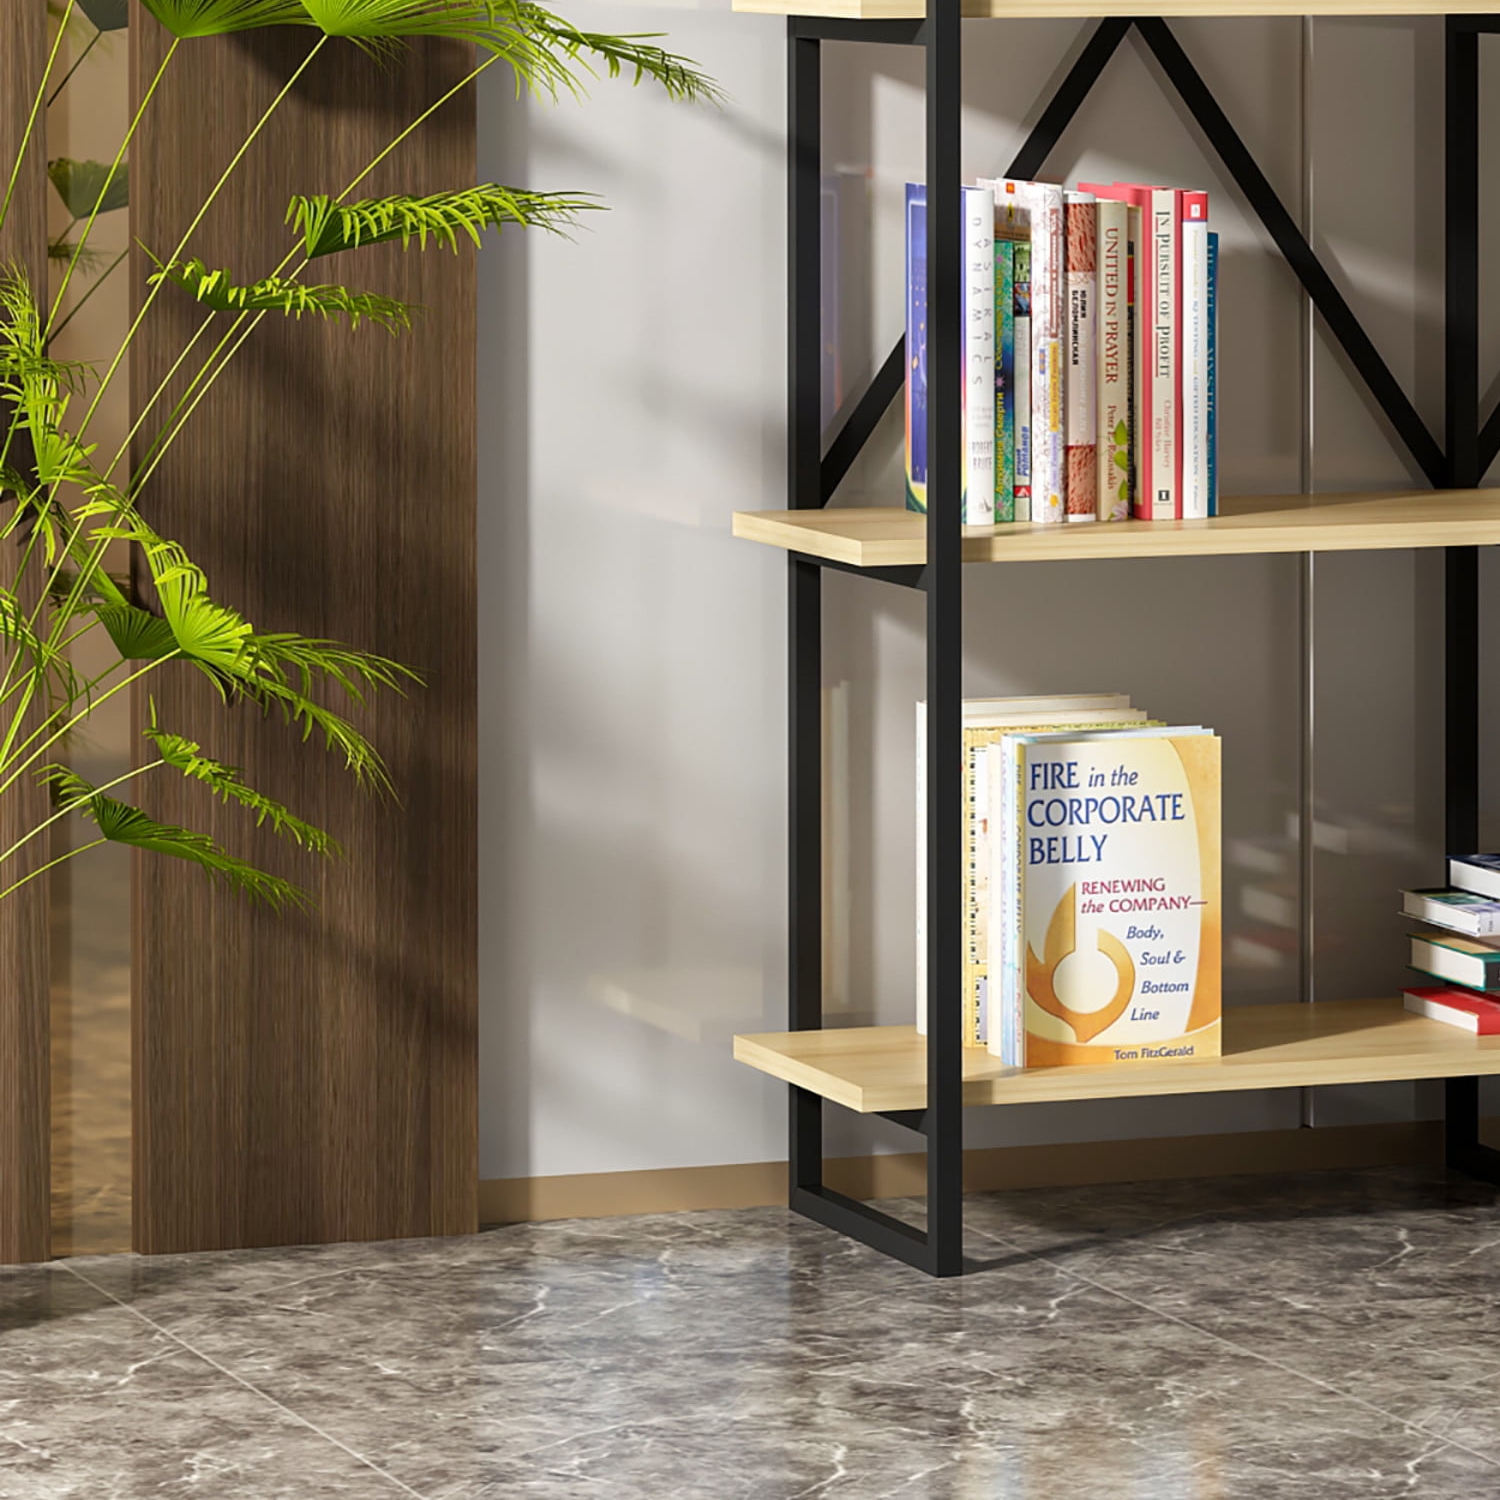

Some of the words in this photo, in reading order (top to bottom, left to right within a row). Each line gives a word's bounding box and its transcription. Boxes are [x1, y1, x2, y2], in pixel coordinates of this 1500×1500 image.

[1157, 211, 1171, 226] IN
[1105, 227, 1119, 297] UNITED
[1157, 234, 1171, 297] PURSUIT
[972, 217, 982, 386] DYNAMICS
[1106, 301, 1117, 316] IN
[1159, 301, 1170, 319] OF
[1105, 321, 1119, 384] PRAYER
[1157, 325, 1171, 379] PROFIT
[1107, 405, 1117, 429] Peter
[1163, 399, 1172, 438] Christine
[1107, 444, 1117, 490] Roussakis
[1162, 440, 1172, 469] Harvey
[1030, 761, 1079, 791] FIRE
[1088, 767, 1107, 787] in
[1111, 765, 1139, 786] the
[1027, 793, 1186, 827] CORPORATE
[1028, 834, 1108, 864] BELLY
[1081, 878, 1166, 896] RENEWING
[1081, 900, 1105, 914] the
[1126, 925, 1165, 941] Body,
[1139, 950, 1170, 966] Soul
[1172, 951, 1187, 965] &
[1140, 979, 1190, 994] Bottom
[1130, 1007, 1160, 1021] Line
[1114, 1048, 1139, 1061] Tom
[1140, 1046, 1195, 1060] FitzGerald
